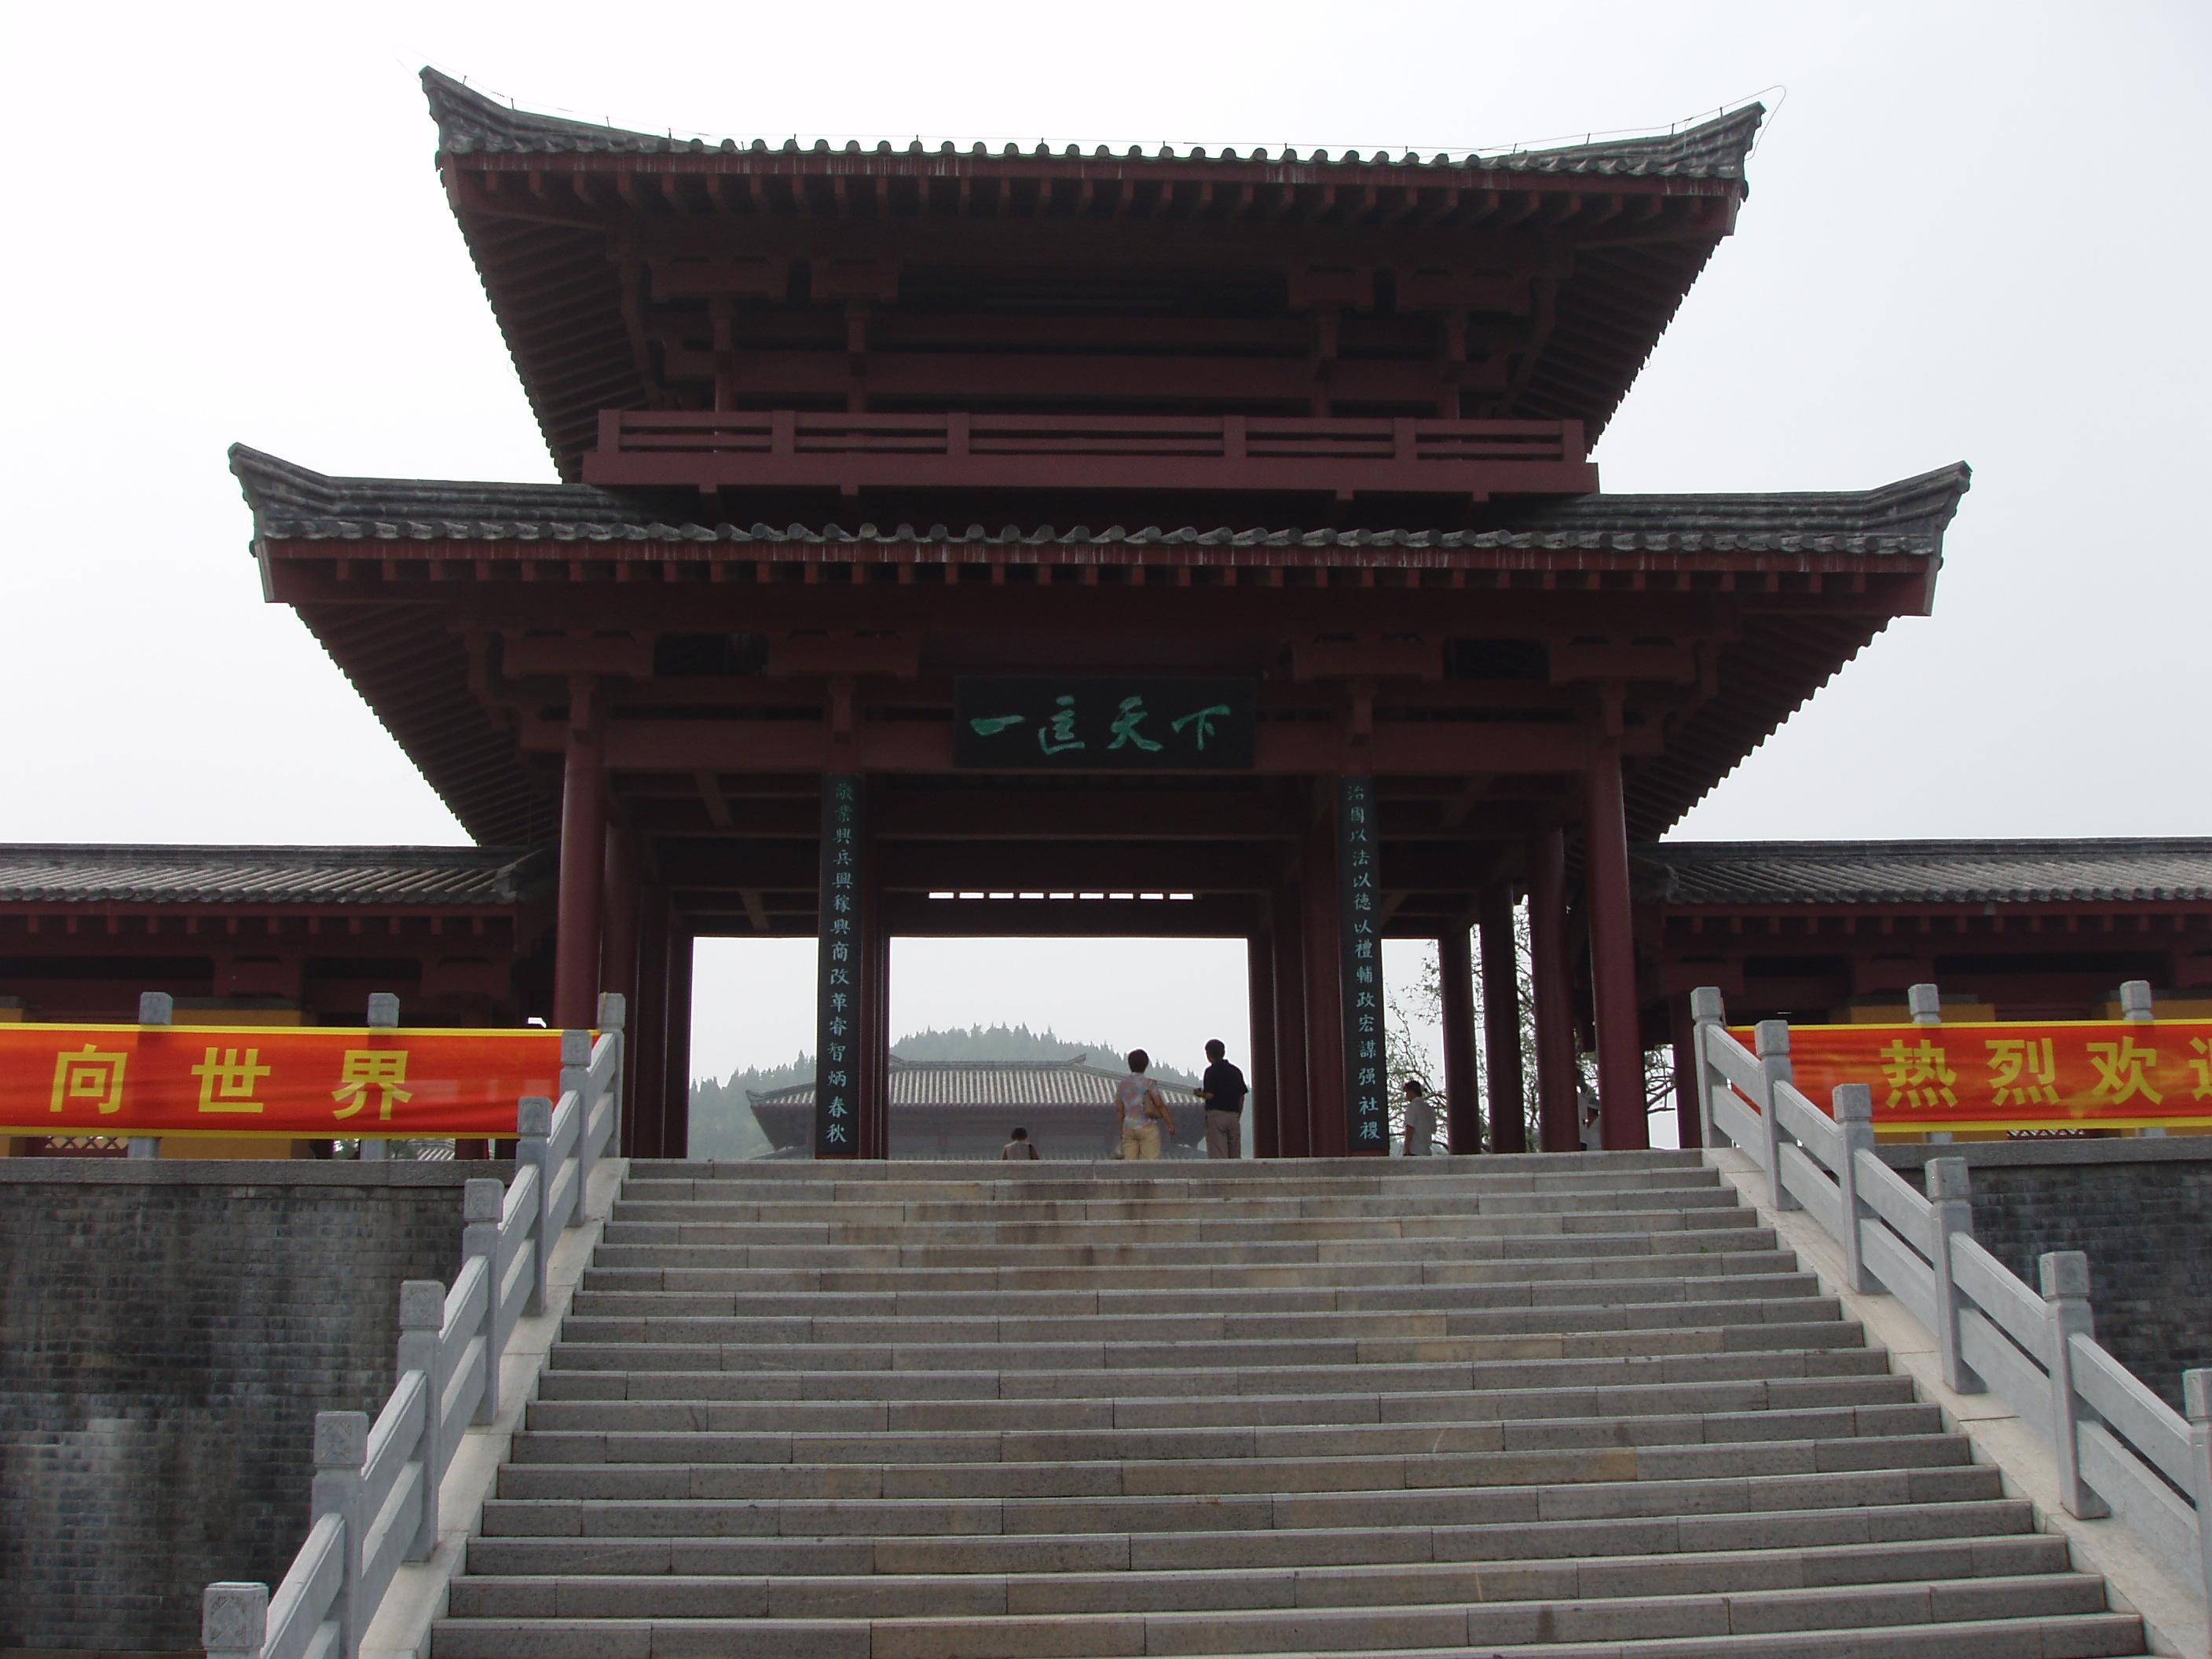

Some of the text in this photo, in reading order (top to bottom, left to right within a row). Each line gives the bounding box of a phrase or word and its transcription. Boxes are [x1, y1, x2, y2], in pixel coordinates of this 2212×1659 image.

[970, 695, 1231, 755] 一匡天下
[49, 1044, 413, 1121] 向世界
